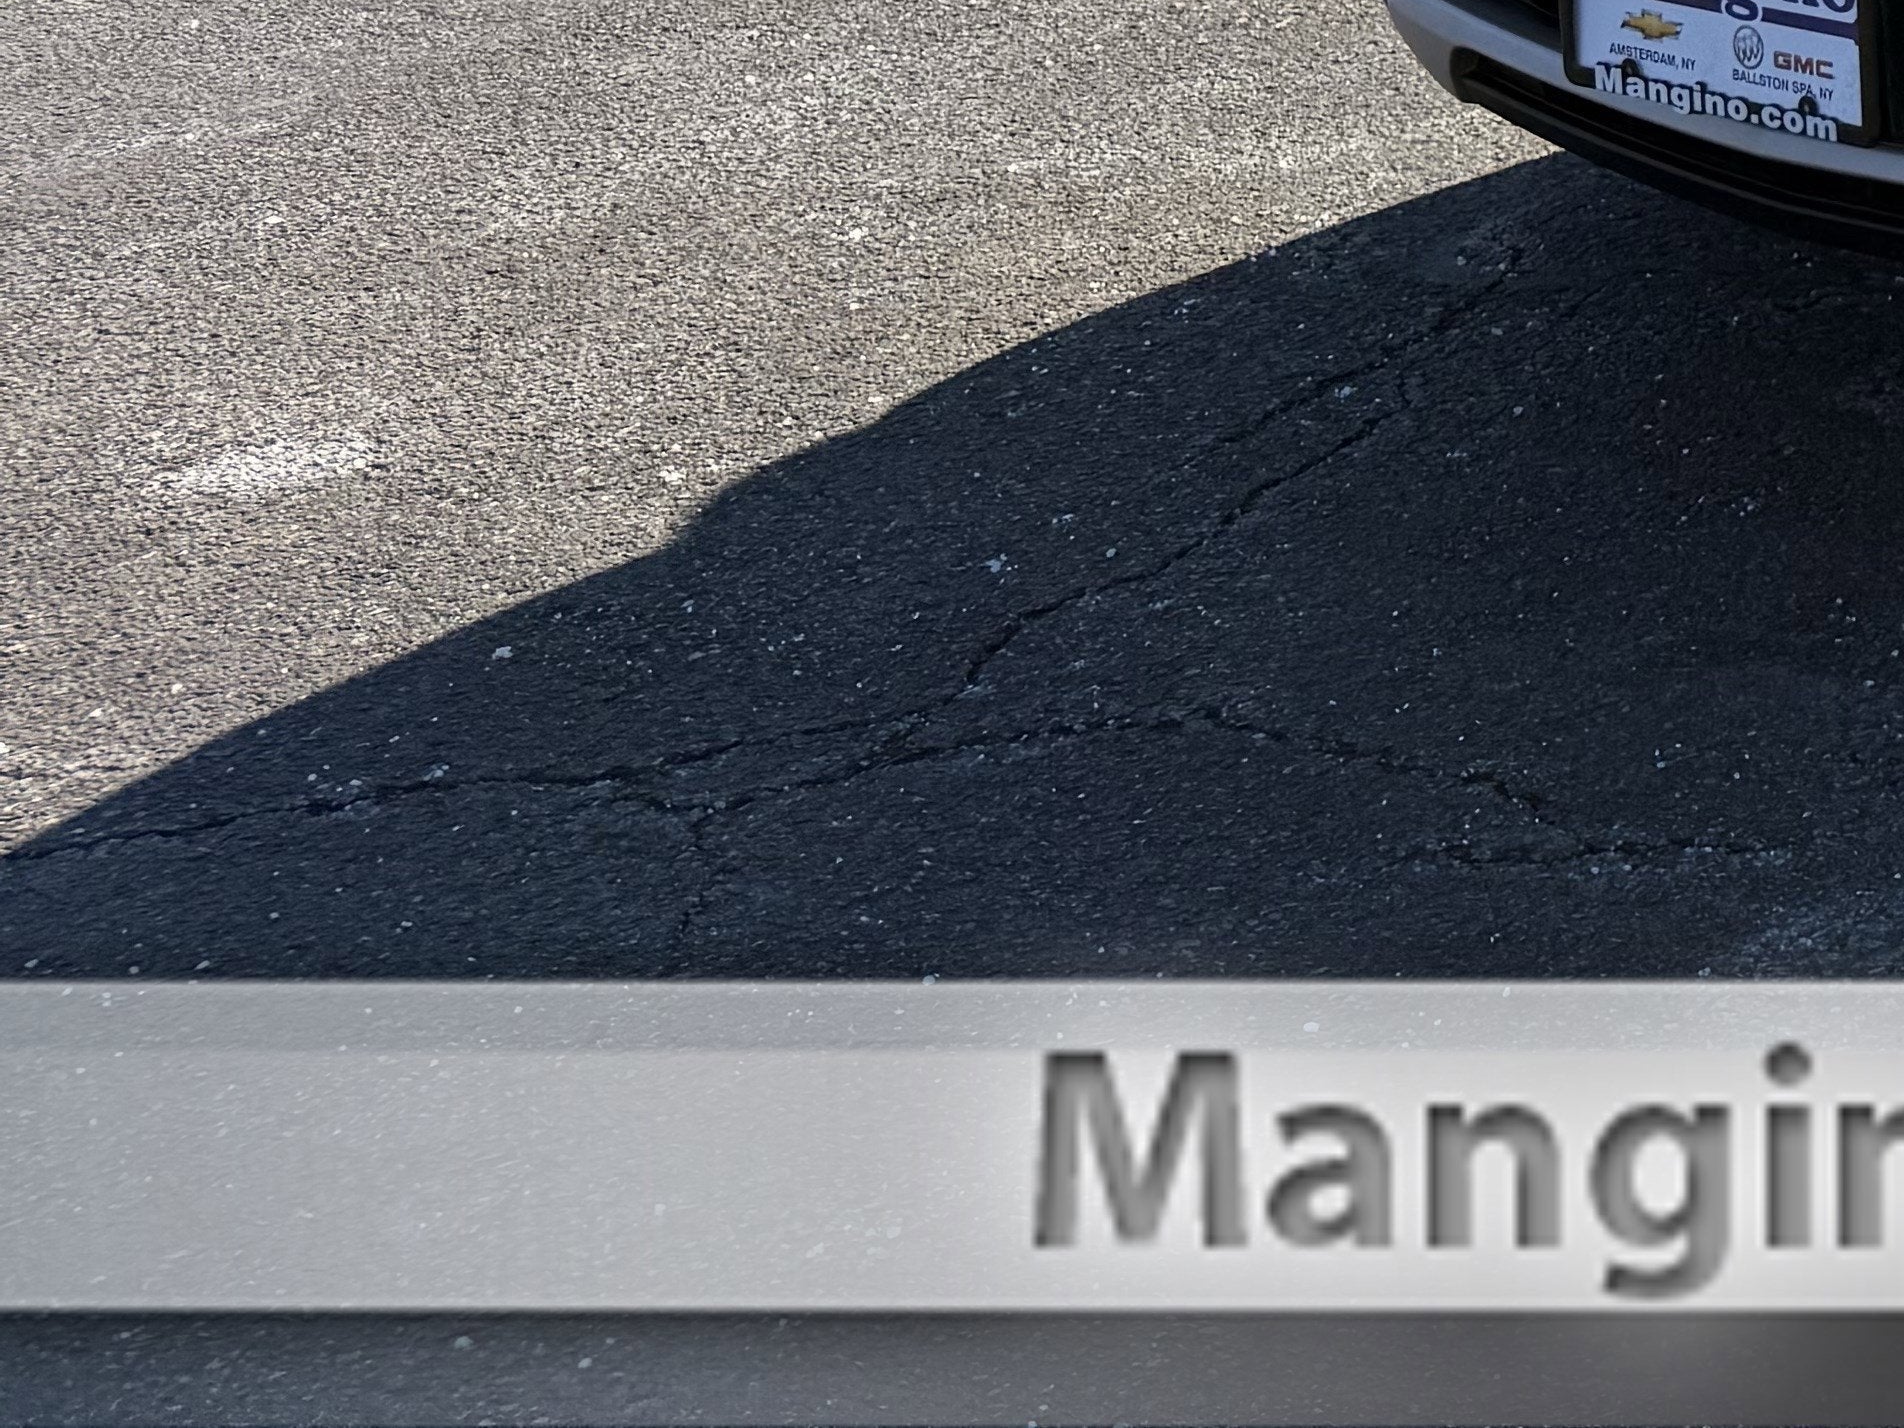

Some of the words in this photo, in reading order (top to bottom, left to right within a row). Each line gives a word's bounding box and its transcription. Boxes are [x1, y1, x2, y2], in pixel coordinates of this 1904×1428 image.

[1609, 42, 1680, 70] AMSTERDAM,
[1681, 56, 1697, 71] NY
[1774, 50, 1835, 79] GMC
[1732, 68, 1789, 92] BALLSTON
[1819, 86, 1834, 101] NY
[1594, 61, 1838, 142] Mangino.com
